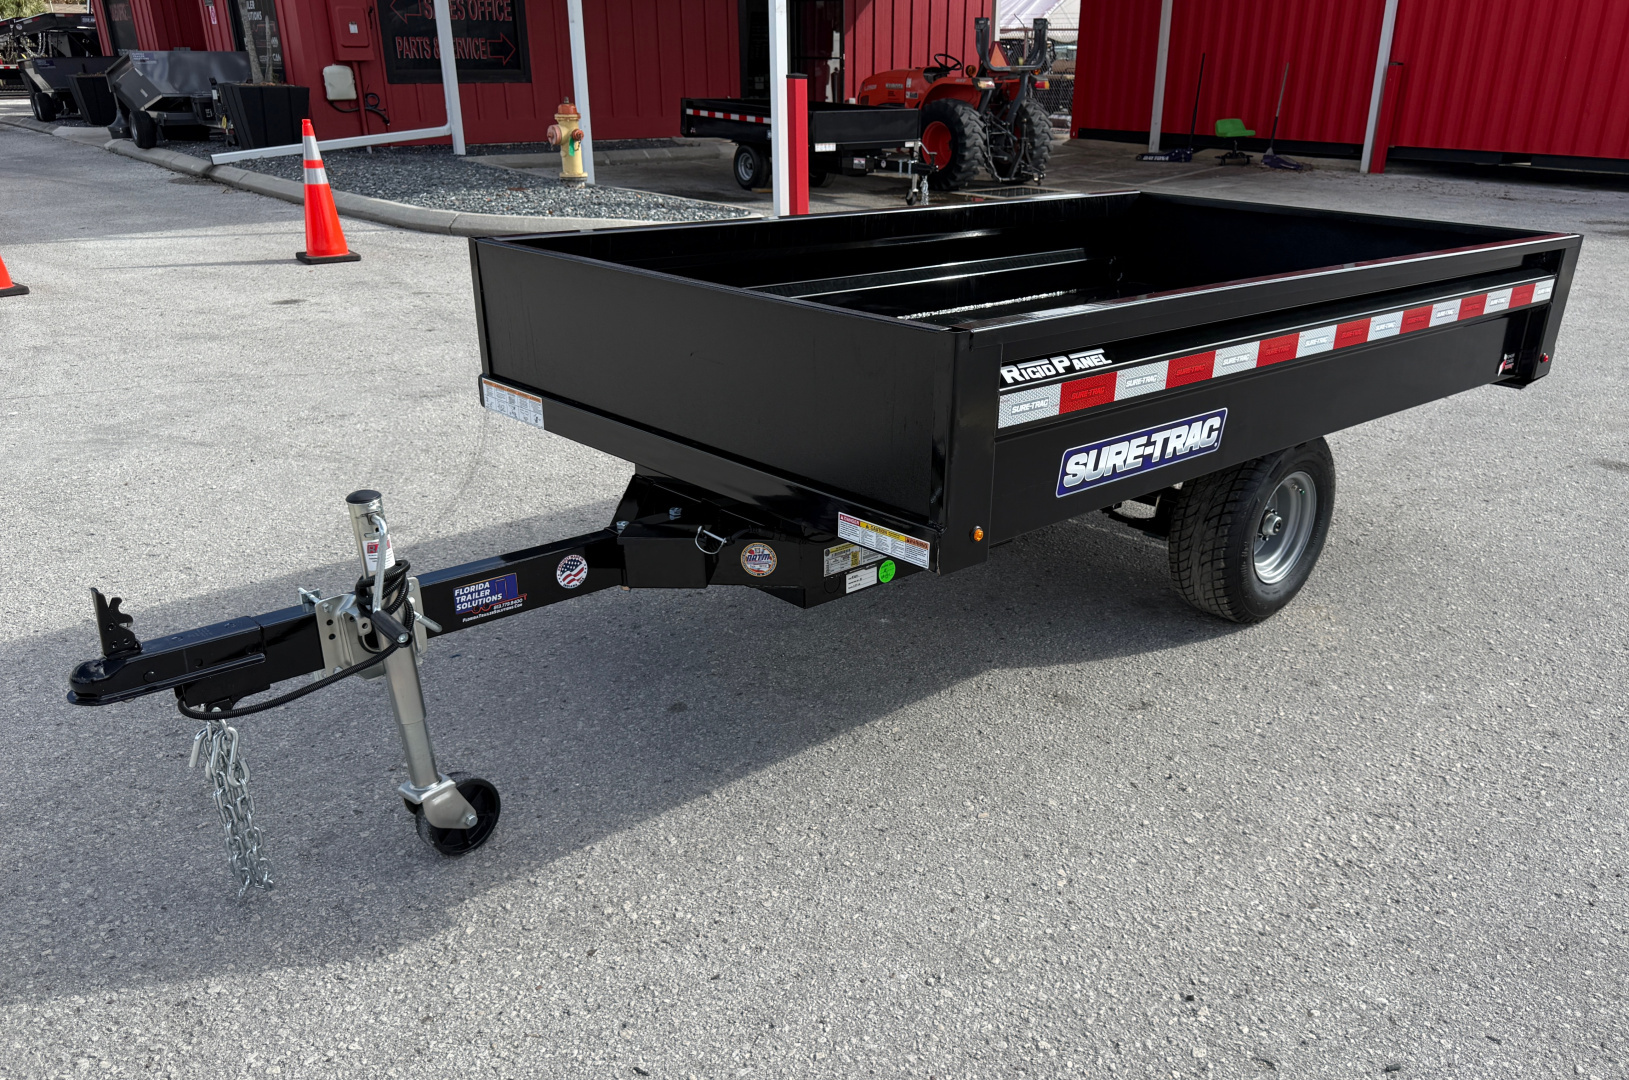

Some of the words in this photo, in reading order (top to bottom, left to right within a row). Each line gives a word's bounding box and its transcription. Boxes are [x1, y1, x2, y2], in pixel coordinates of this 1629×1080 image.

[424, 0, 466, 20] SES
[468, 0, 513, 21] OFFICE
[395, 36, 432, 59] PARTS
[452, 38, 488, 60] ERVICE
[1011, 398, 1049, 415] SURE-TRAC
[1062, 415, 1222, 488] SURE-TRAC
[455, 581, 490, 596] FLORIDA
[456, 589, 491, 603] TRAILER
[456, 593, 503, 611] SOLUTIONS
